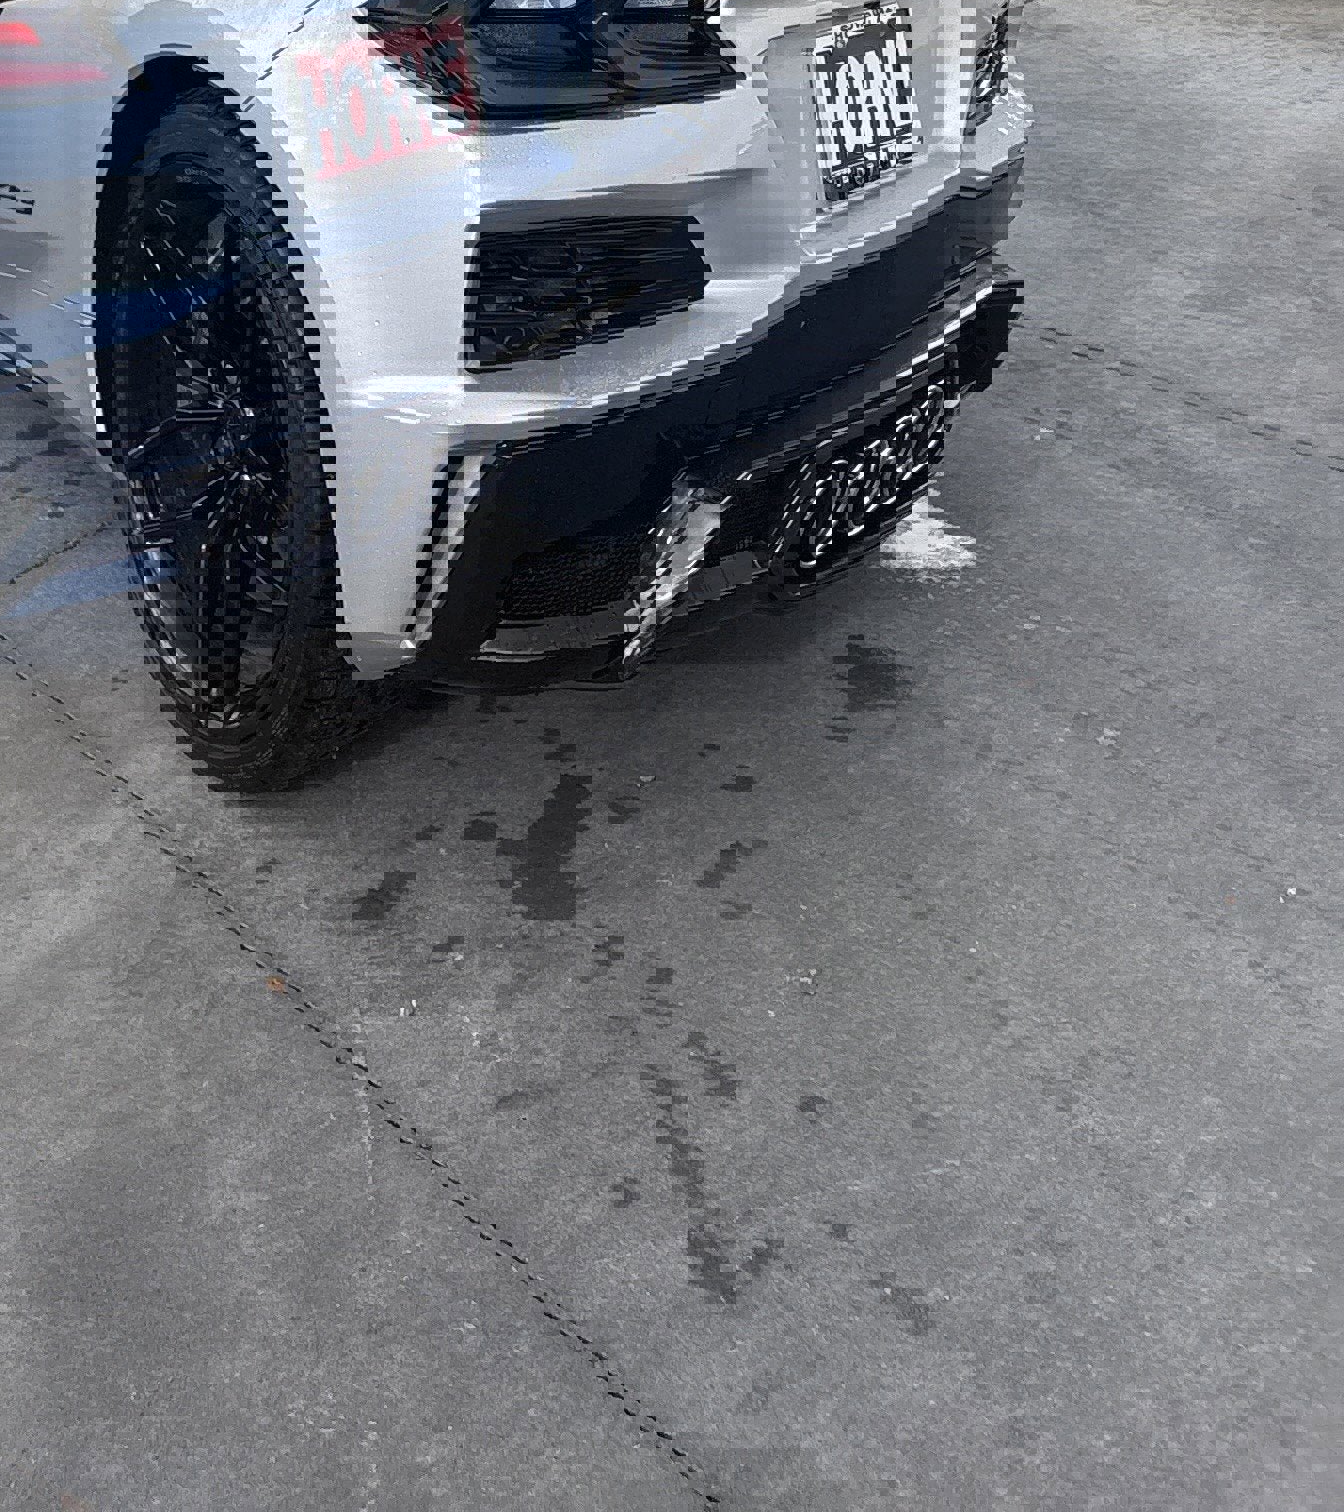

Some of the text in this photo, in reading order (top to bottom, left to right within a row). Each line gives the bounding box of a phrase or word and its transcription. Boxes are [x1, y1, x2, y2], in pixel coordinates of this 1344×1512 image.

[328, 25, 369, 44] SHOW
[412, 10, 430, 23] AZ
[301, 38, 471, 173] HORNE
